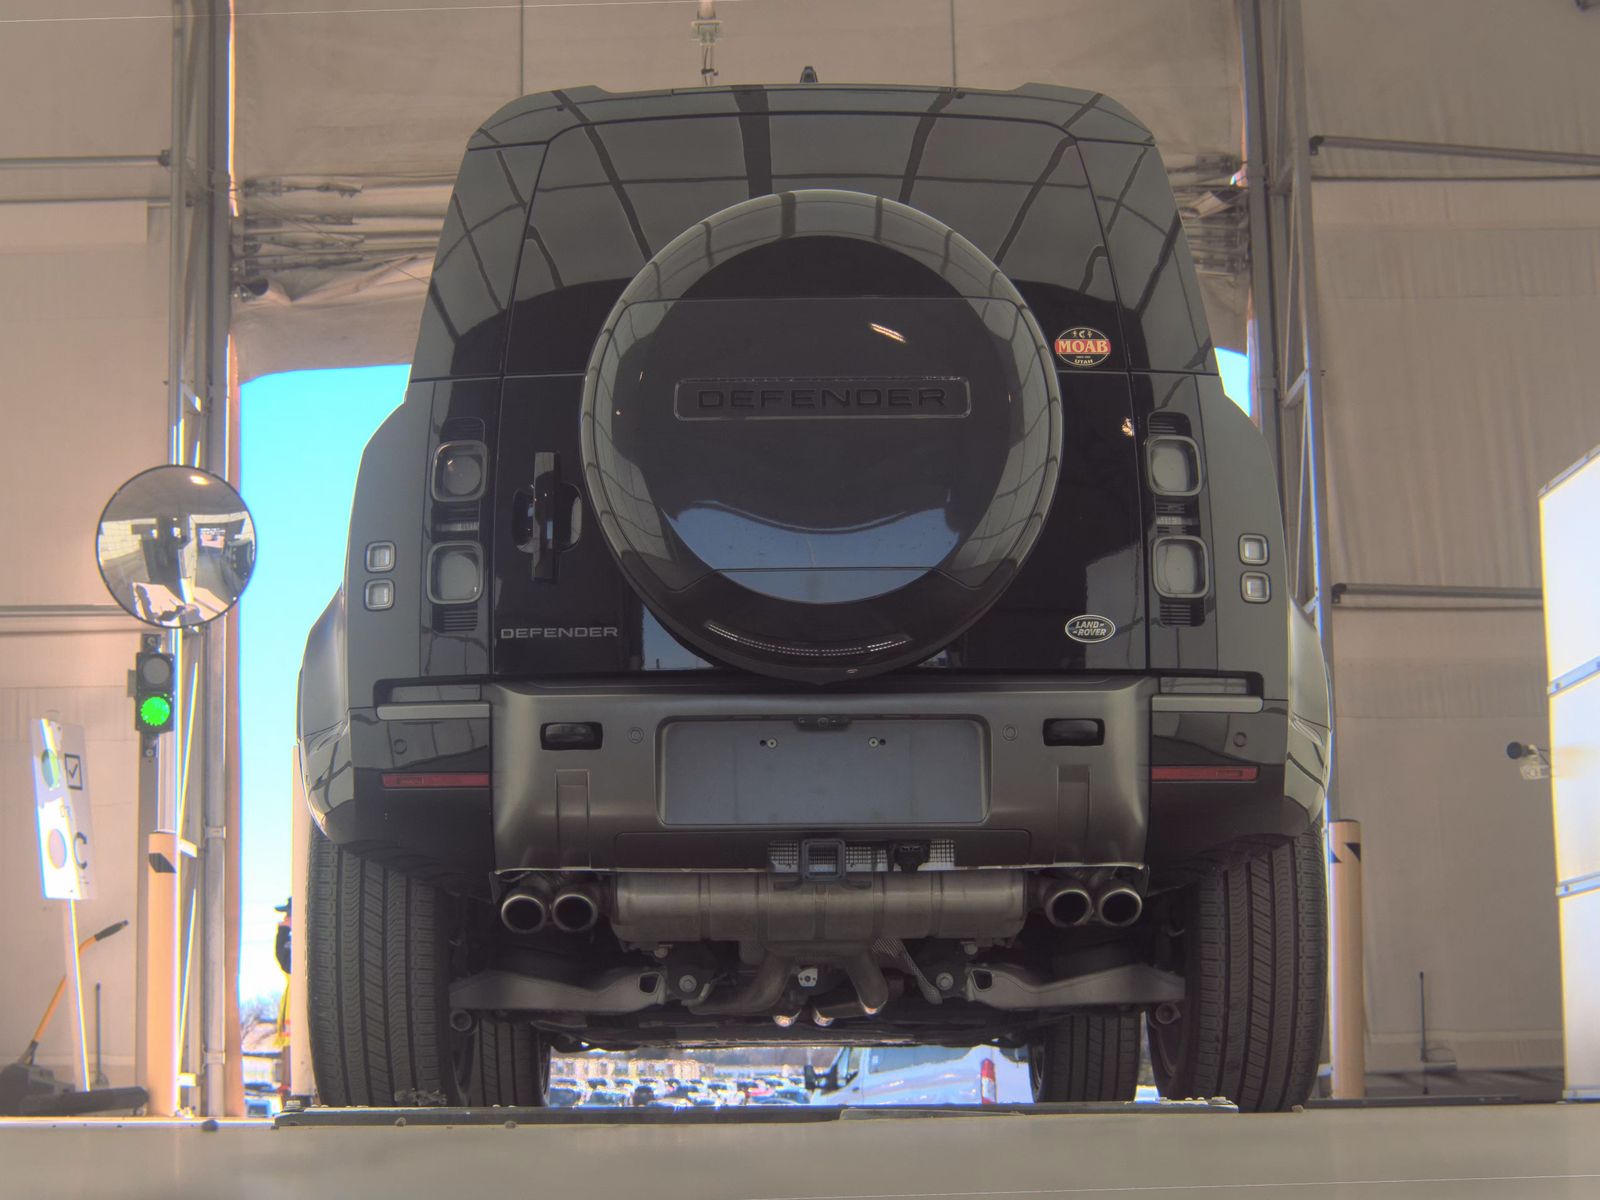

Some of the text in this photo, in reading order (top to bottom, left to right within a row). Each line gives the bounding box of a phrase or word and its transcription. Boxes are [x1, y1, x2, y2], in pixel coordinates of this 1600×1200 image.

[1058, 340, 1108, 353] MOAB
[697, 387, 946, 409] DEFENDER
[1075, 620, 1100, 629] LAND
[500, 627, 618, 639] DEFENDER
[1077, 628, 1107, 636] ROVER
